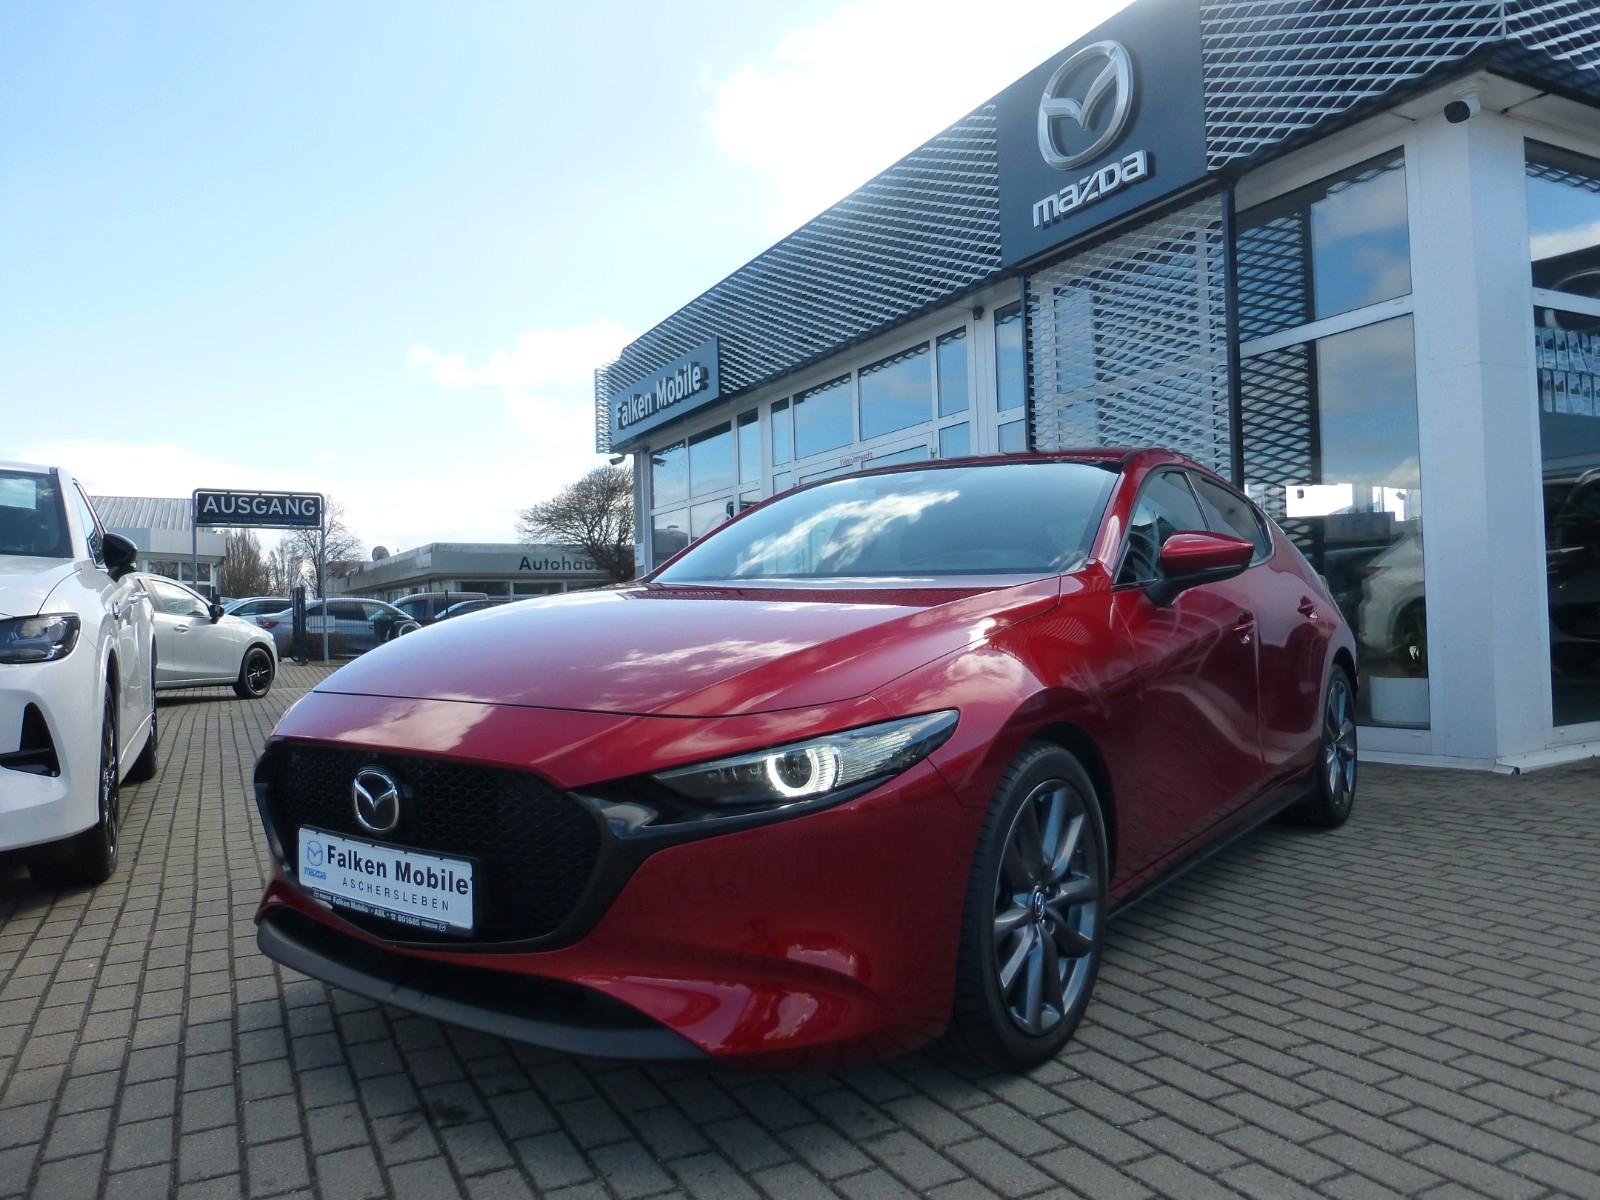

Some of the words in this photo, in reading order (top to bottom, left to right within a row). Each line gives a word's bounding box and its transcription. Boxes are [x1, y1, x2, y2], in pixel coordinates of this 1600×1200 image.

[615, 392, 653, 430] Falken
[656, 361, 701, 410] Mobile
[203, 495, 316, 516] AUSGANG
[519, 556, 602, 571] Autohau
[327, 844, 387, 878] Falken
[395, 860, 469, 895] Mobile
[342, 877, 449, 911] ASCHERSLEBEN
